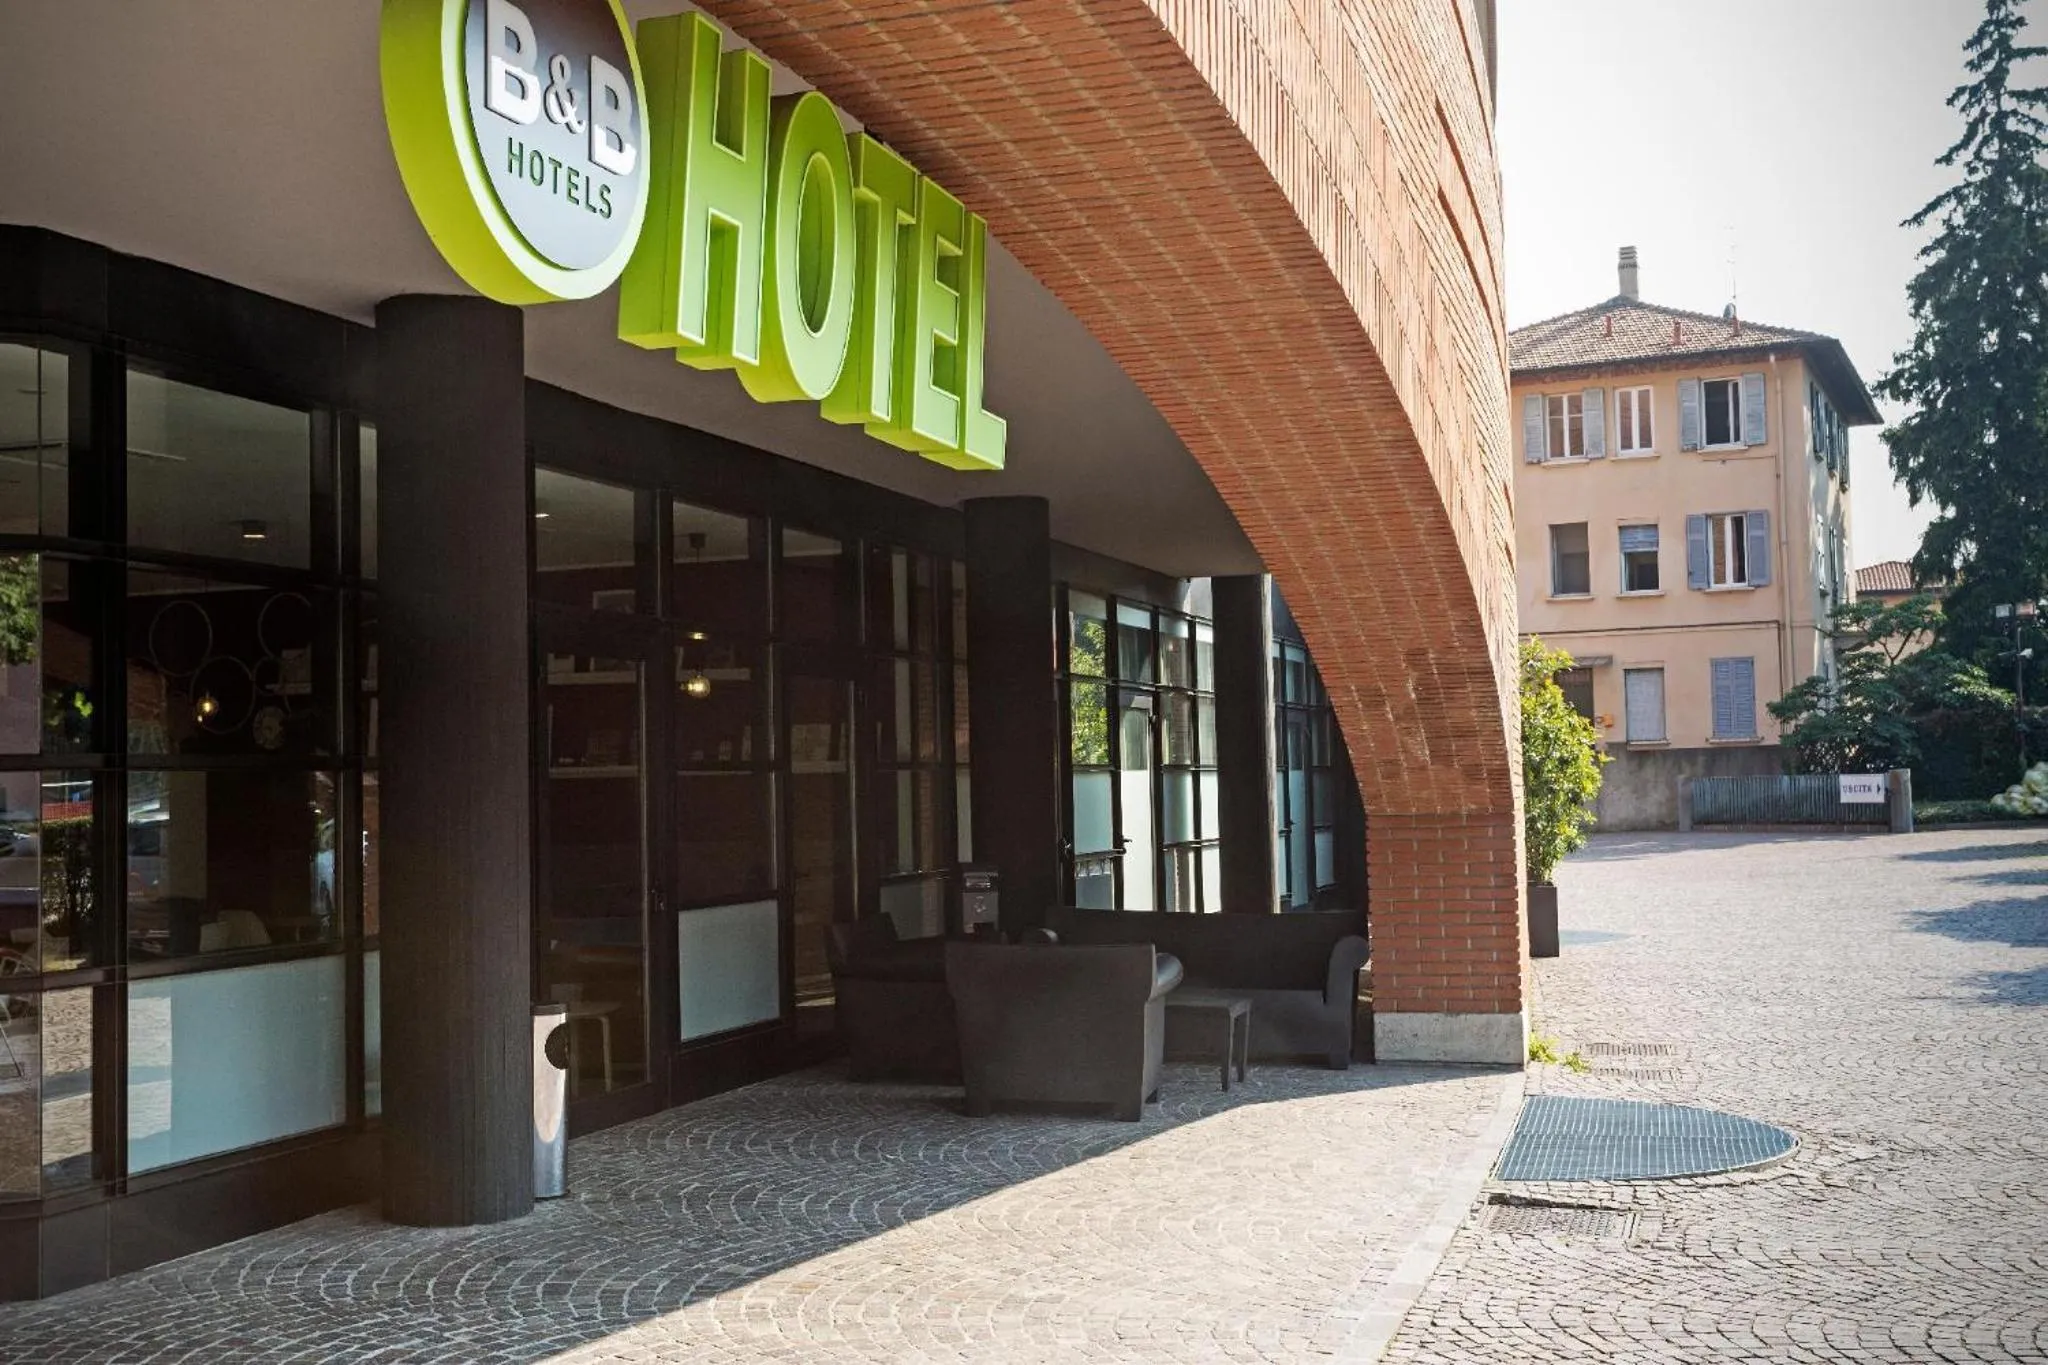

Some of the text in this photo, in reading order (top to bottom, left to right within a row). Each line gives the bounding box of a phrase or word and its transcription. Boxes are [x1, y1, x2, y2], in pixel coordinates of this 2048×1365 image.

[485, 0, 637, 176] B&B
[507, 136, 613, 219] HOTELS
[620, 11, 1007, 470] HOTEL
